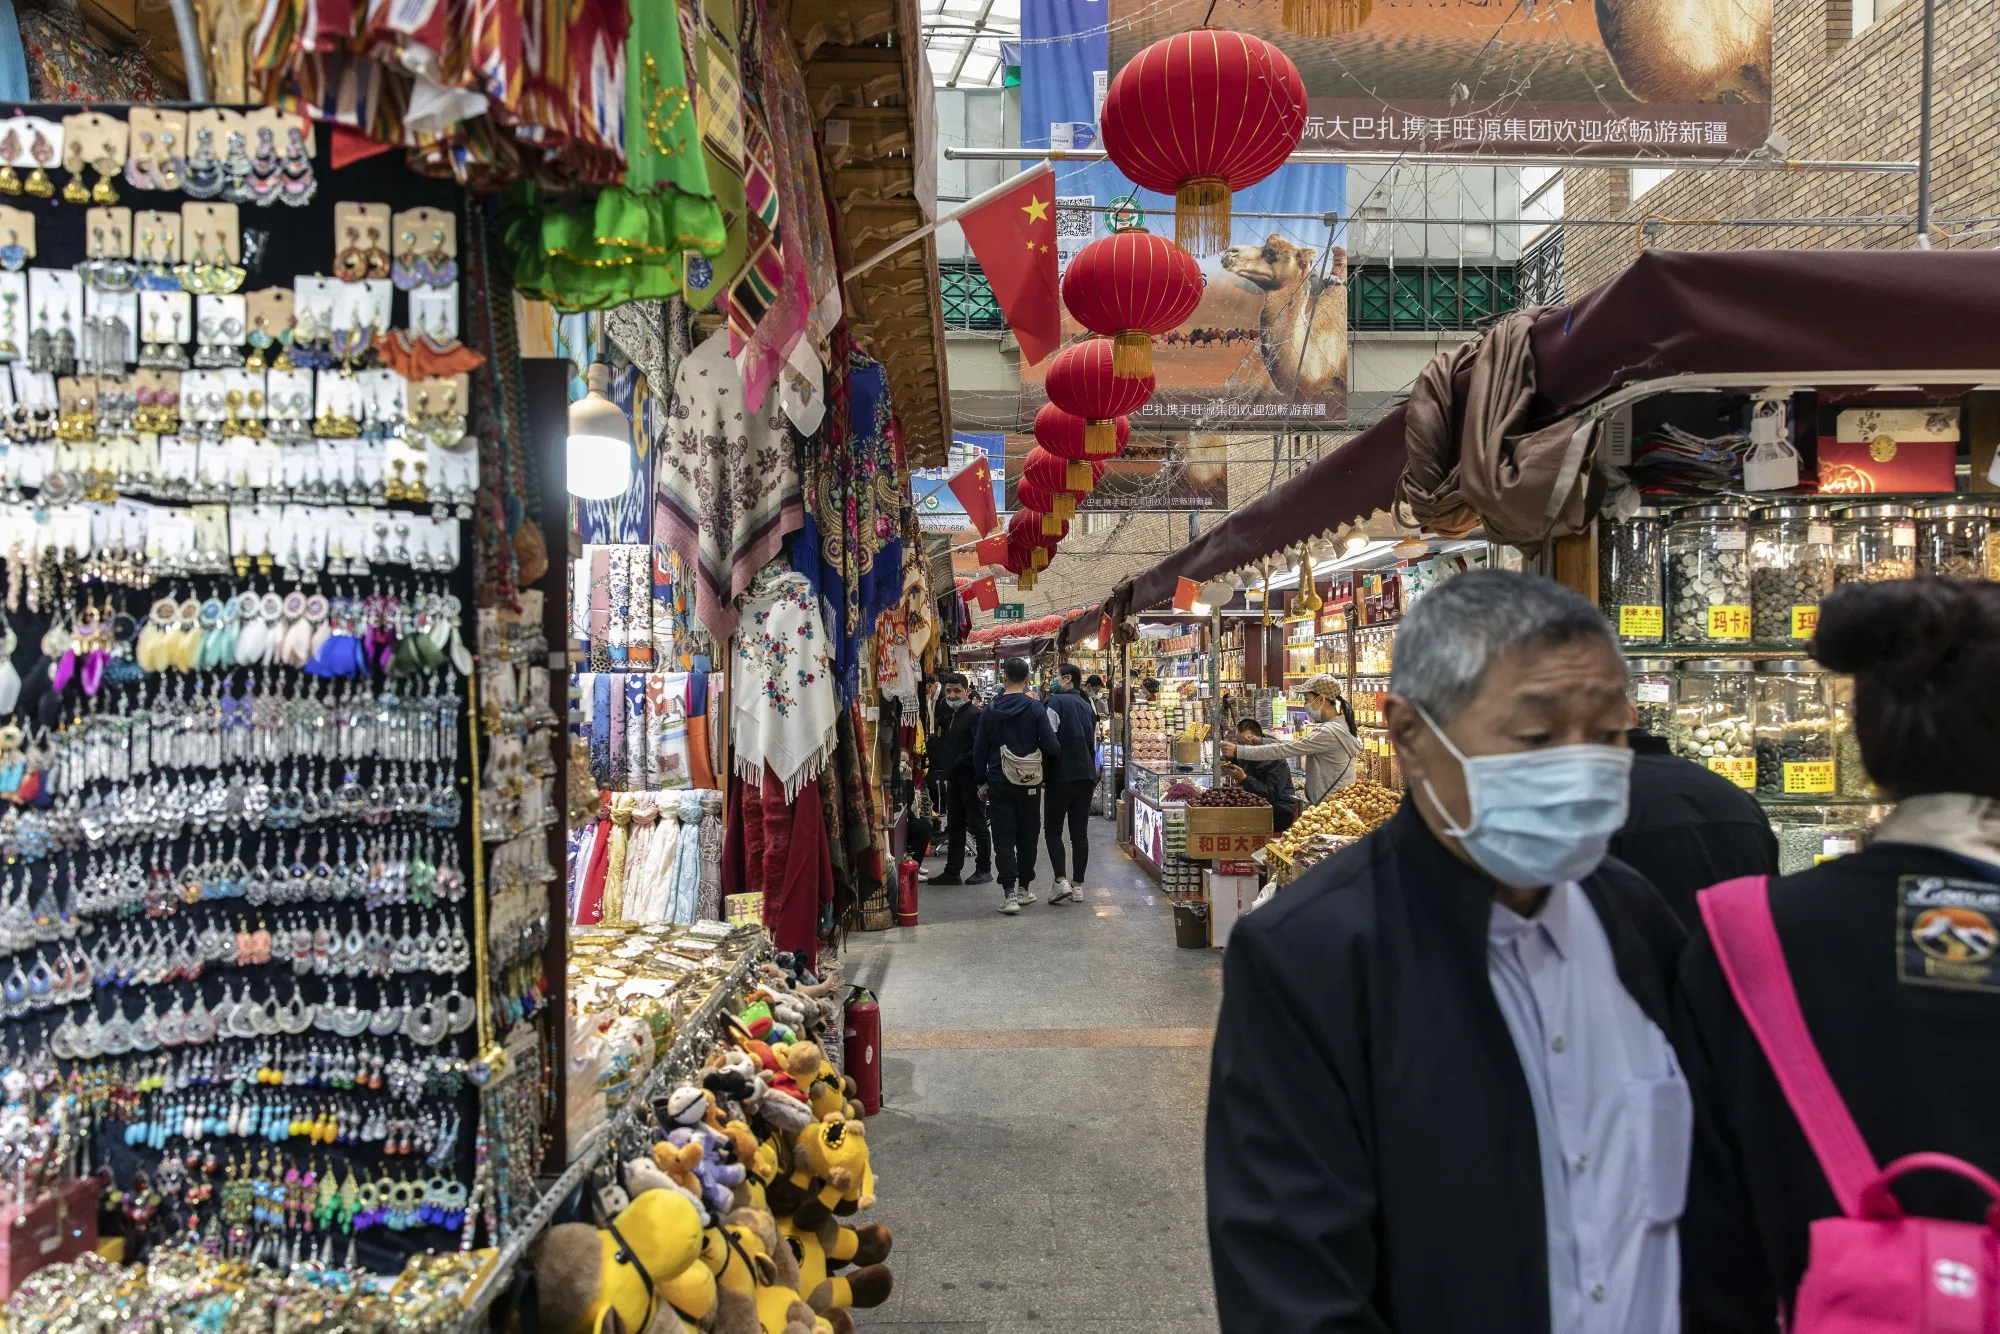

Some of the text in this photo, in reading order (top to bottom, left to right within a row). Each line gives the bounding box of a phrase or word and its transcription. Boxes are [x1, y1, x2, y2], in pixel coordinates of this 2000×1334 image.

[1301, 115, 1729, 145] 际大巴扎携手旺源集团欢迎您畅游新疆
[999, 609, 1019, 618] 出口
